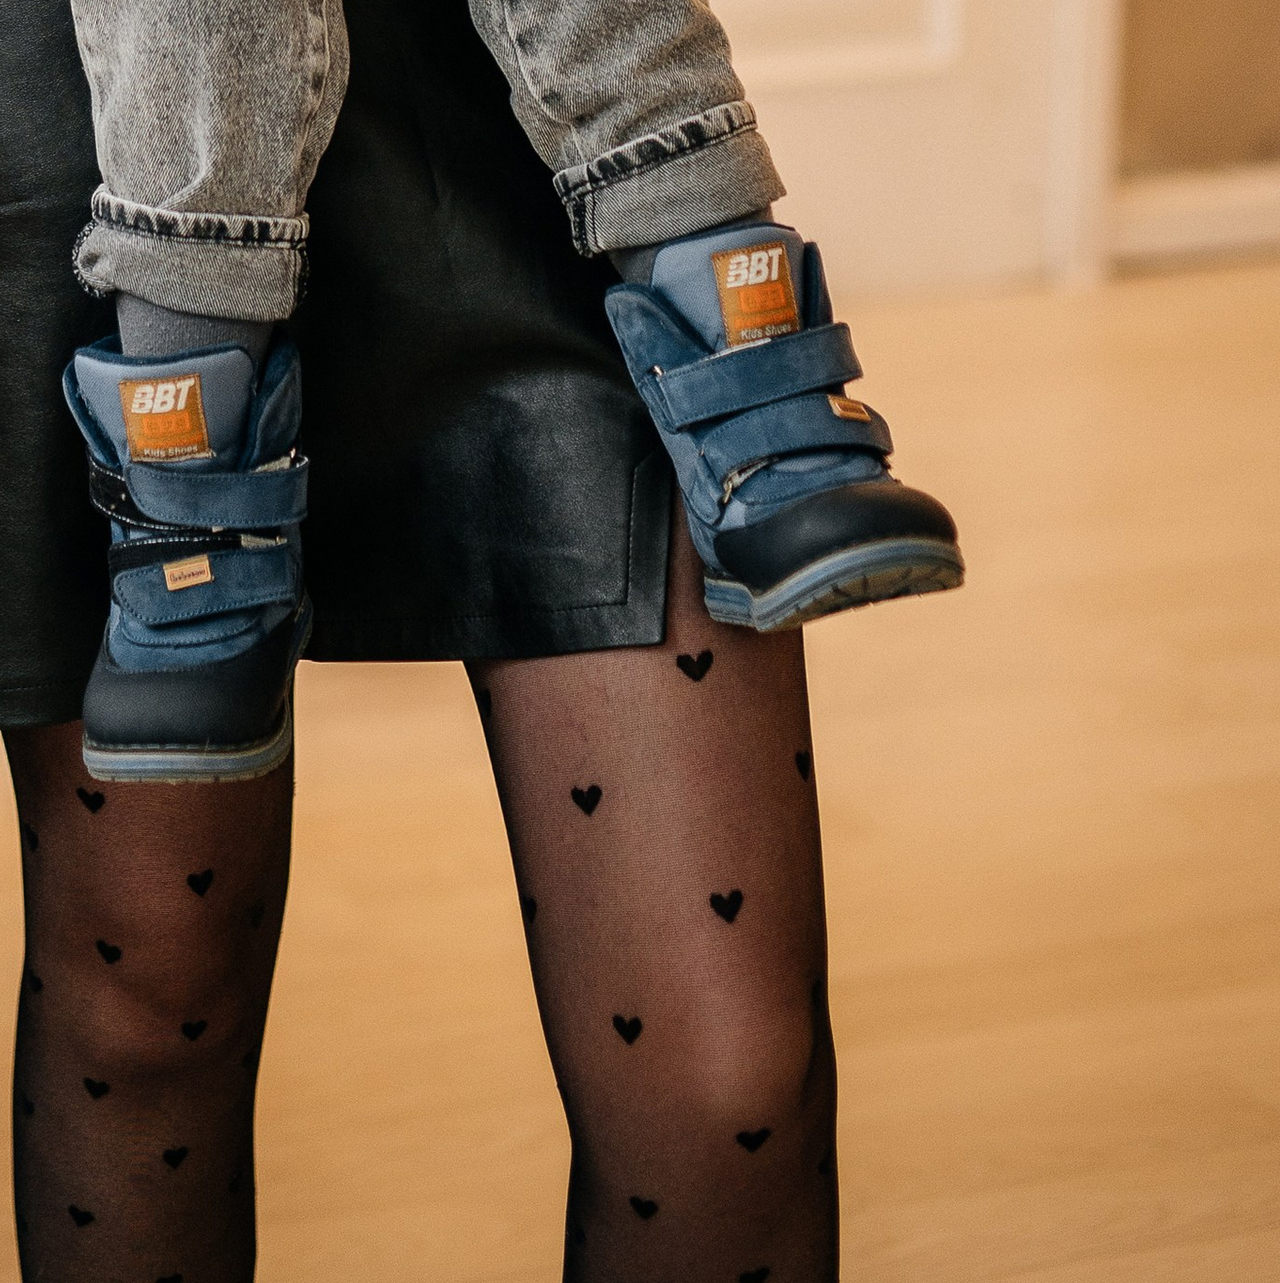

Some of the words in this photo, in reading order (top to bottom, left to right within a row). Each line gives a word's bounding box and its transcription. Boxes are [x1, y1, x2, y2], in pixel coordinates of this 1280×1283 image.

[726, 246, 783, 288] BBT
[741, 327, 763, 339] Kids
[765, 322, 792, 335] Shoes
[131, 377, 195, 414] BBT
[143, 447, 166, 457] Kids
[168, 445, 198, 456] Shoes
